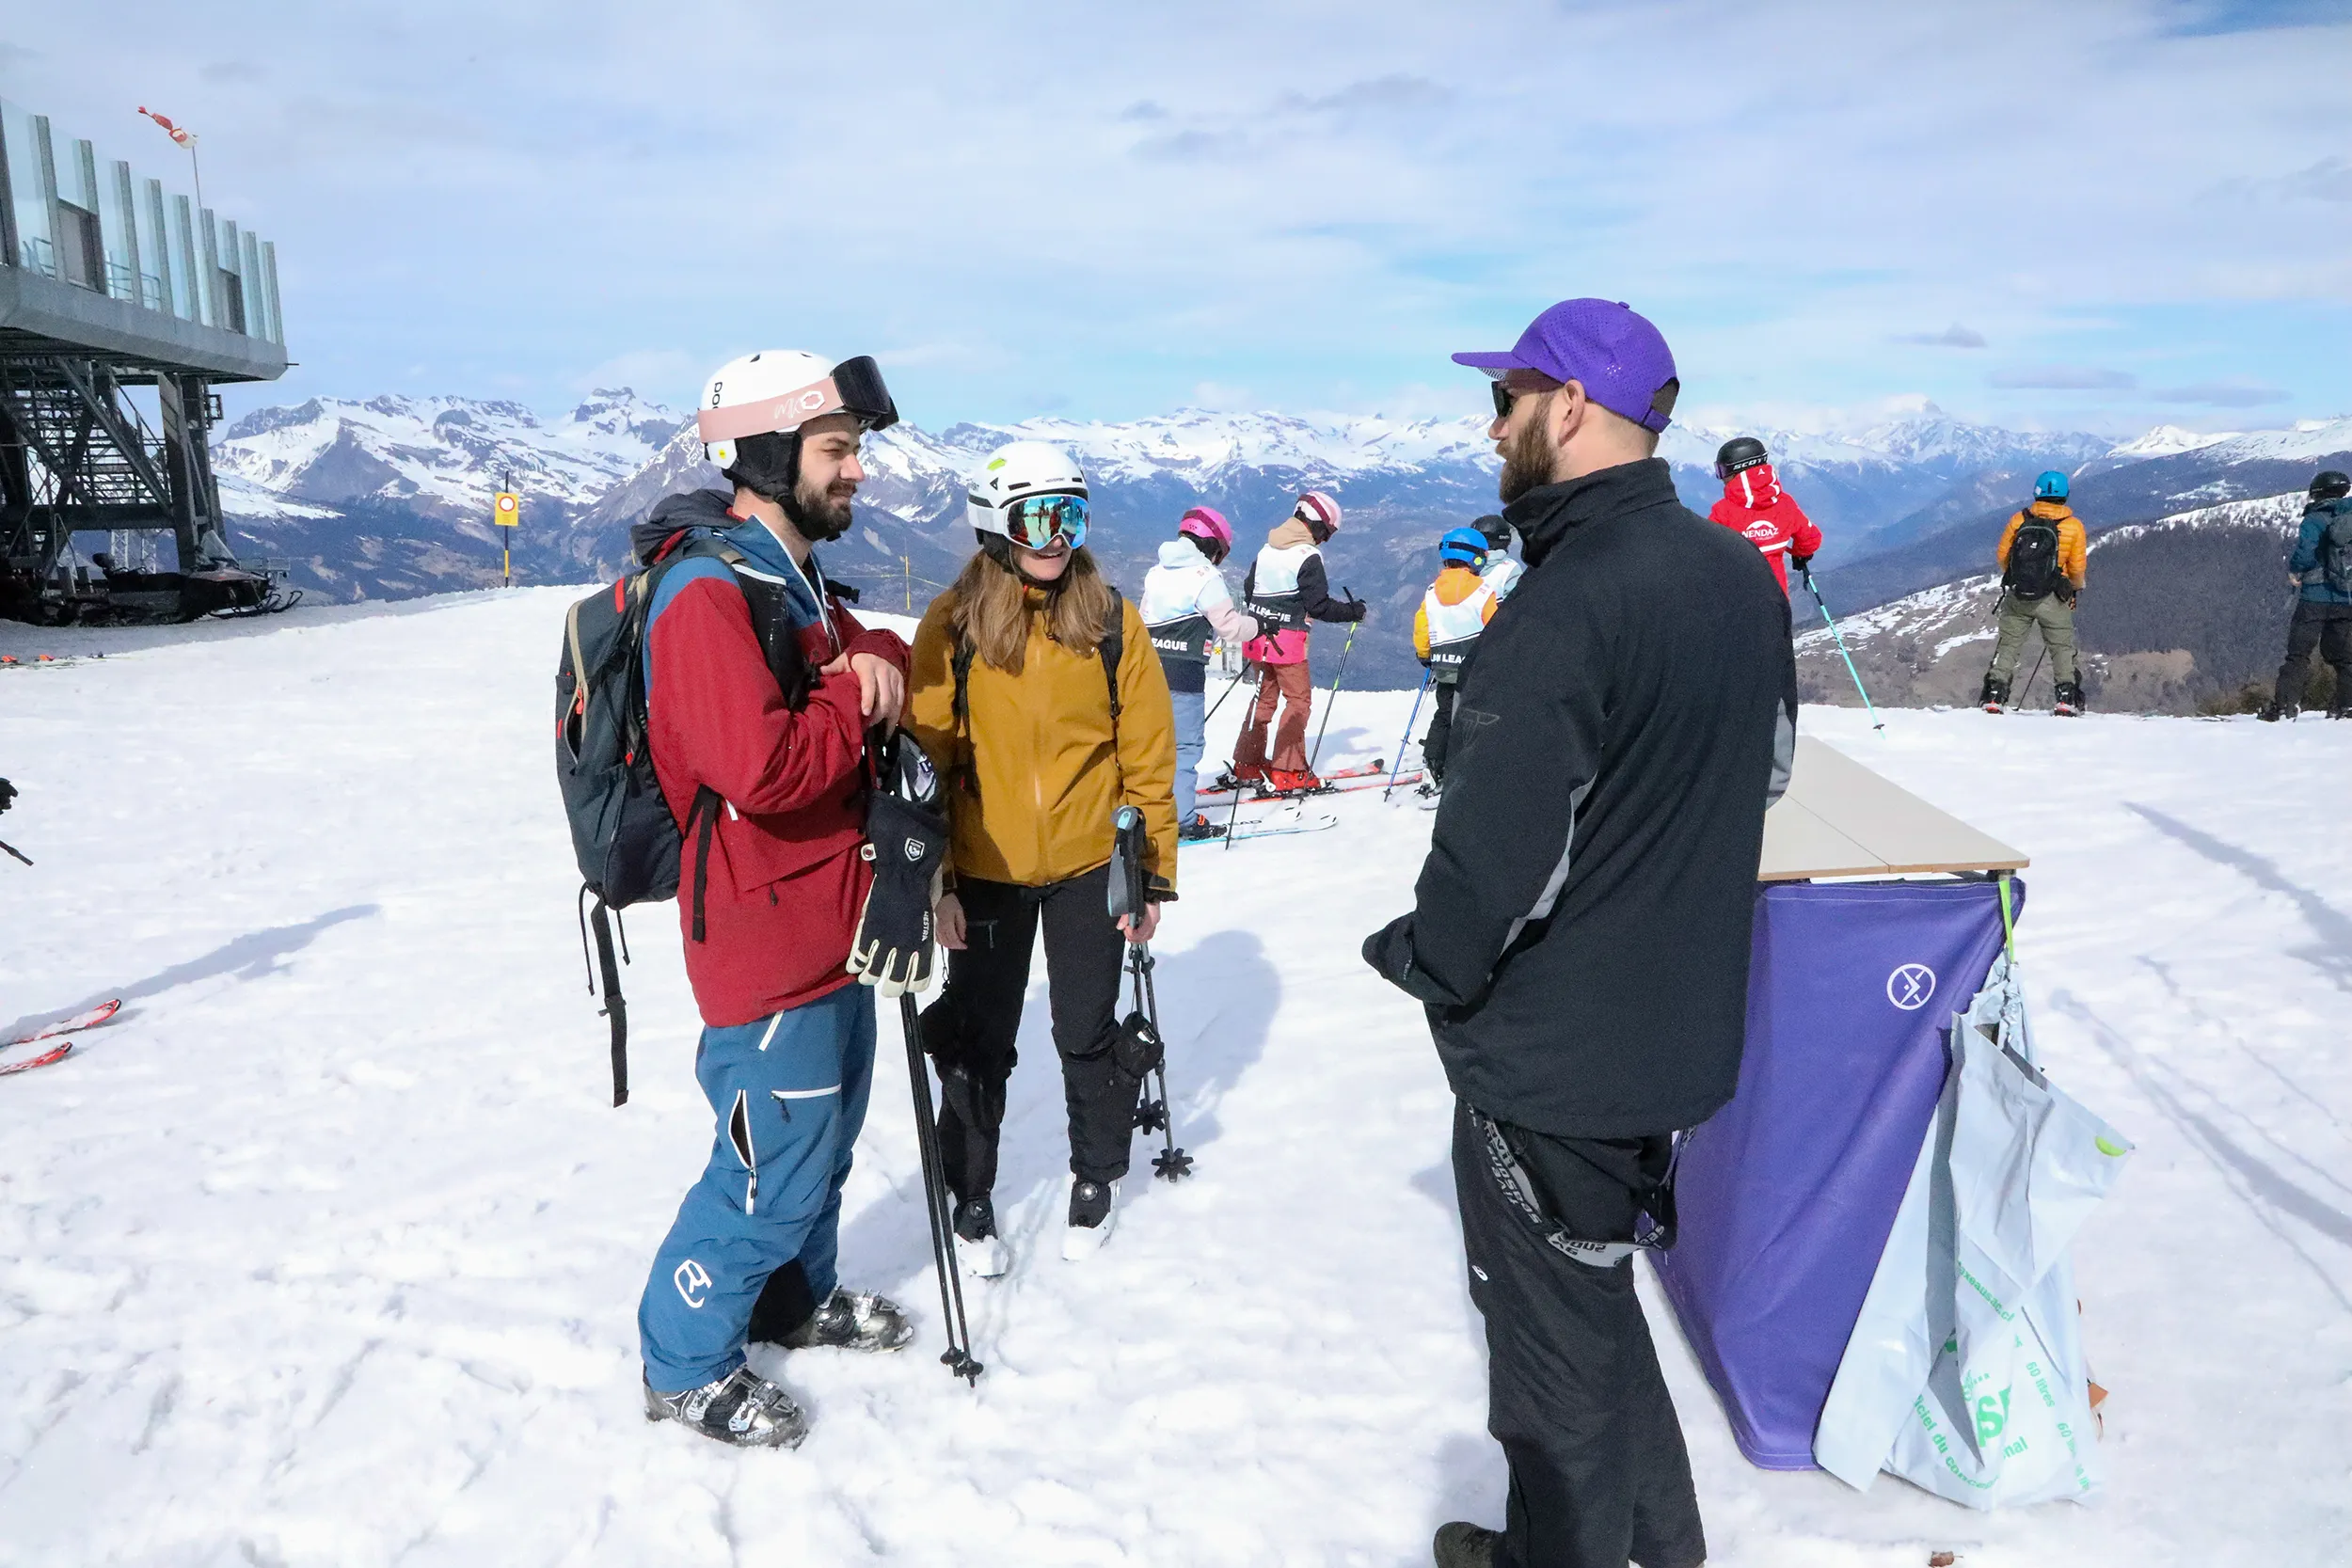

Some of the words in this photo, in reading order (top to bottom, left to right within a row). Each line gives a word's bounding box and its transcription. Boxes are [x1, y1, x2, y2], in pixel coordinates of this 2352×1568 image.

[1741, 527, 1779, 538] NENDAZ
[1151, 637, 1187, 651] EAGUE
[1441, 653, 1466, 664] LEA
[1932, 1433, 1948, 1453] du
